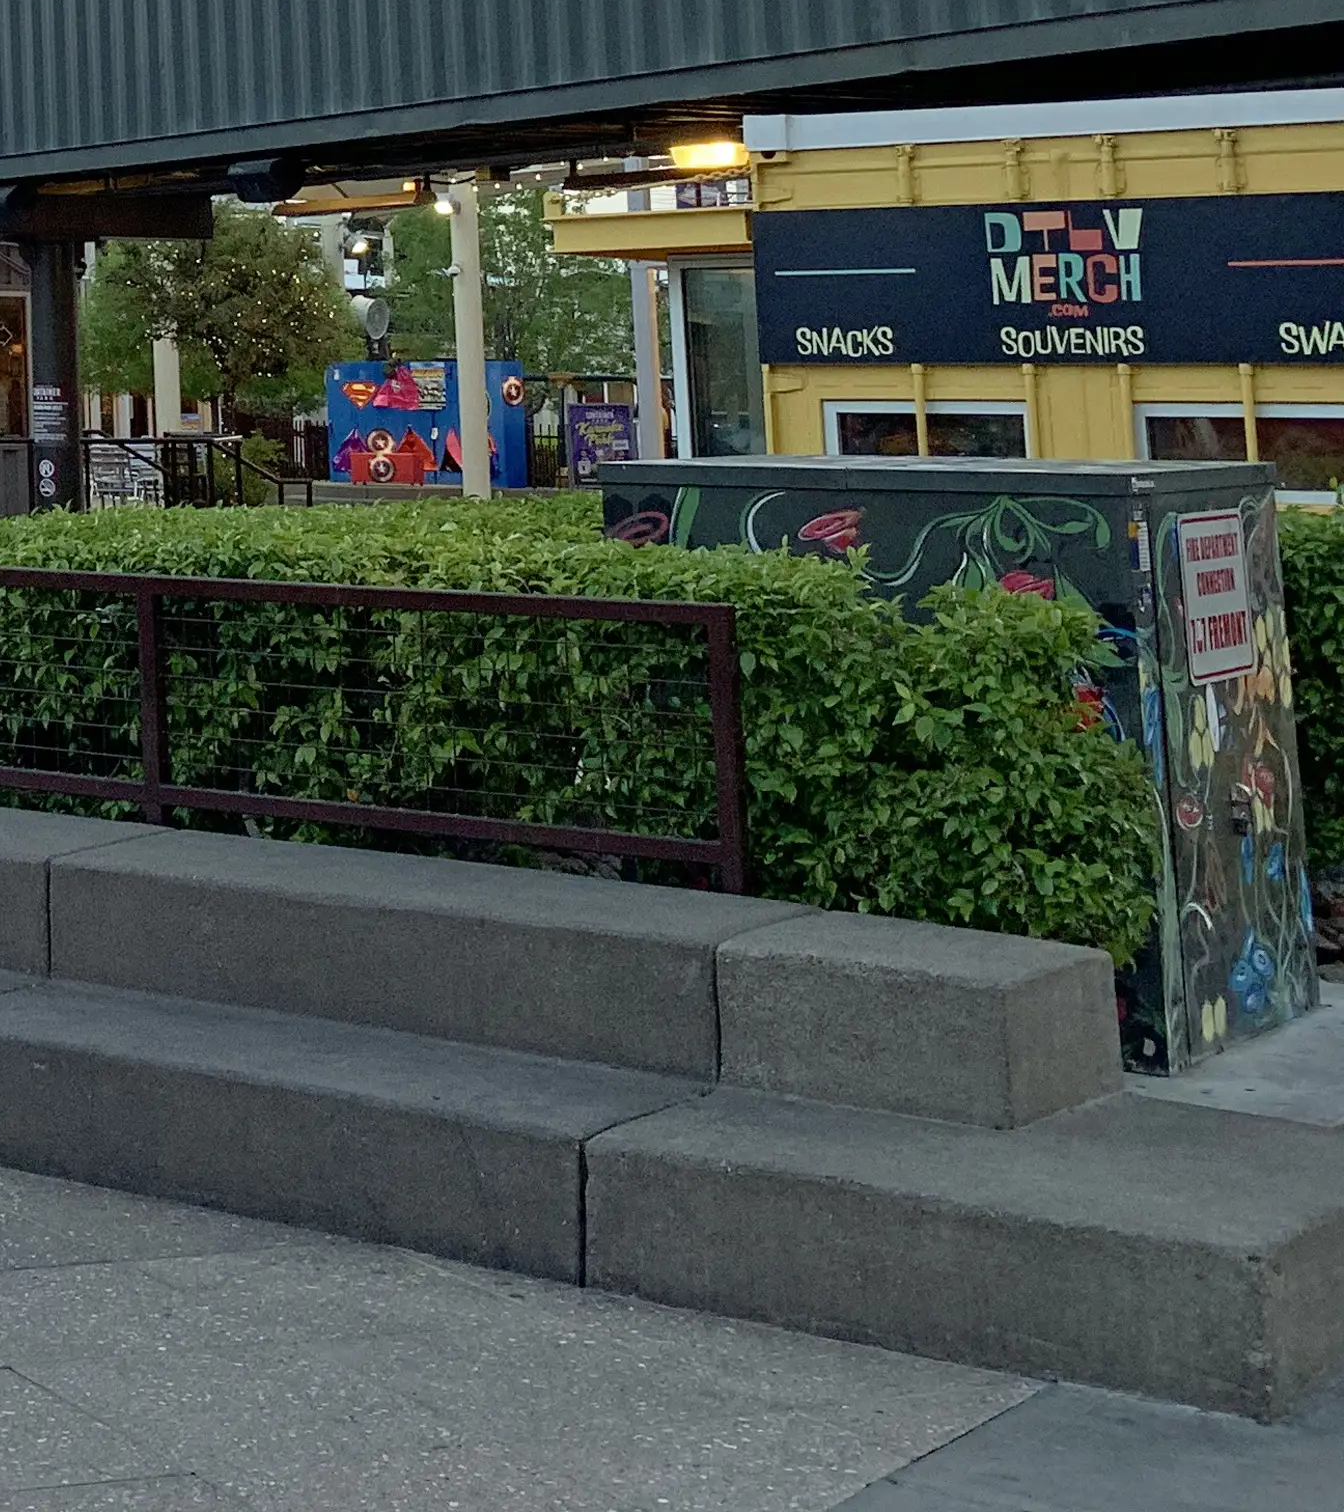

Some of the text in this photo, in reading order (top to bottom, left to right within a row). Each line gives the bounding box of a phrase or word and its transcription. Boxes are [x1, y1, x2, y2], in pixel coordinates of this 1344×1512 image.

[984, 208, 1143, 253] DTLV
[989, 253, 1142, 305] MERCH
[1048, 304, 1089, 317] .COM
[796, 326, 893, 357] SNACKS
[1000, 326, 1144, 356] SOUVENIRS
[1186, 537, 1200, 562] FIRE
[1208, 610, 1247, 650] FREMONT
